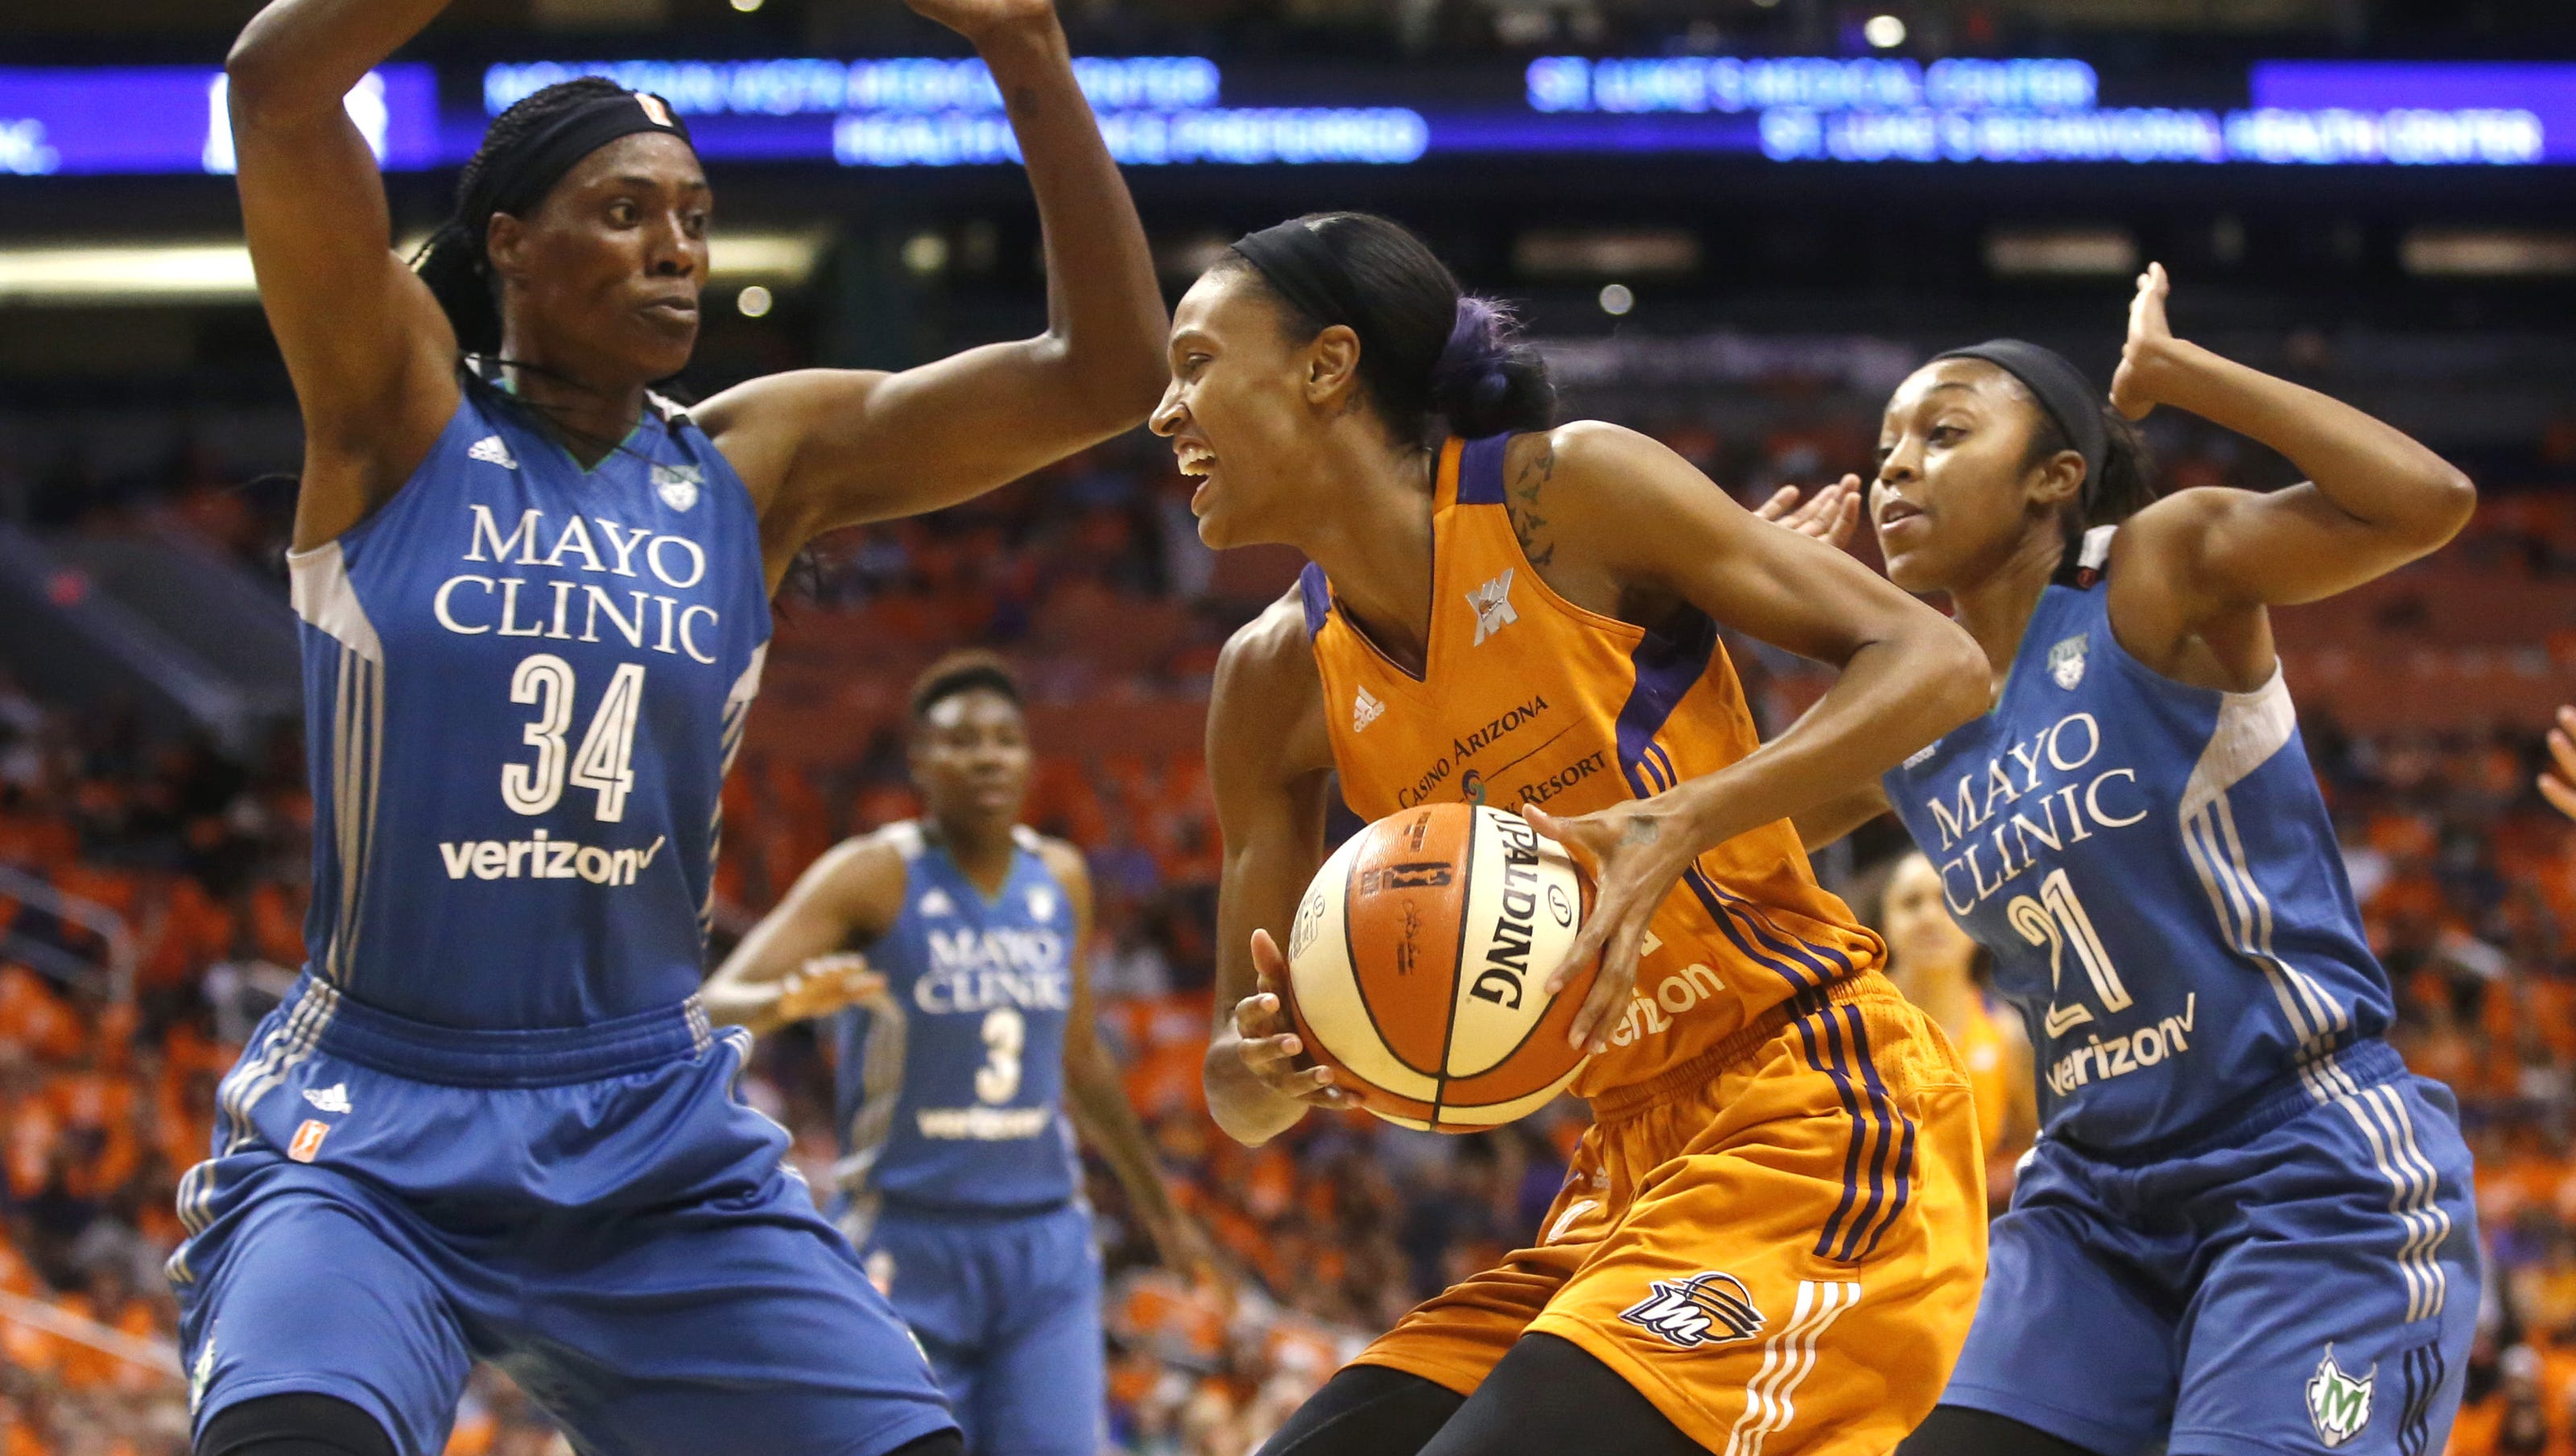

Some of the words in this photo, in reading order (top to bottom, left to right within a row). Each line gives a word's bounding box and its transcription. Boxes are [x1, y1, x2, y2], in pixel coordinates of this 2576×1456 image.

[462, 504, 706, 588] MAYO
[433, 575, 719, 665] CLINIC
[501, 653, 646, 823] 34
[1397, 757, 1450, 809] CASINO
[1454, 695, 1550, 765] ARIZONA
[1517, 751, 1607, 805] RESORT
[1927, 712, 2100, 852] MAYO
[440, 828, 638, 886] verizon
[1941, 769, 2148, 916] CLINIC
[927, 926, 1064, 969] MAYO
[2007, 868, 2133, 1039] 21
[1596, 963, 1726, 1054] erizon
[975, 1006, 1027, 1106] 3
[2045, 1016, 2190, 1097] verizon
